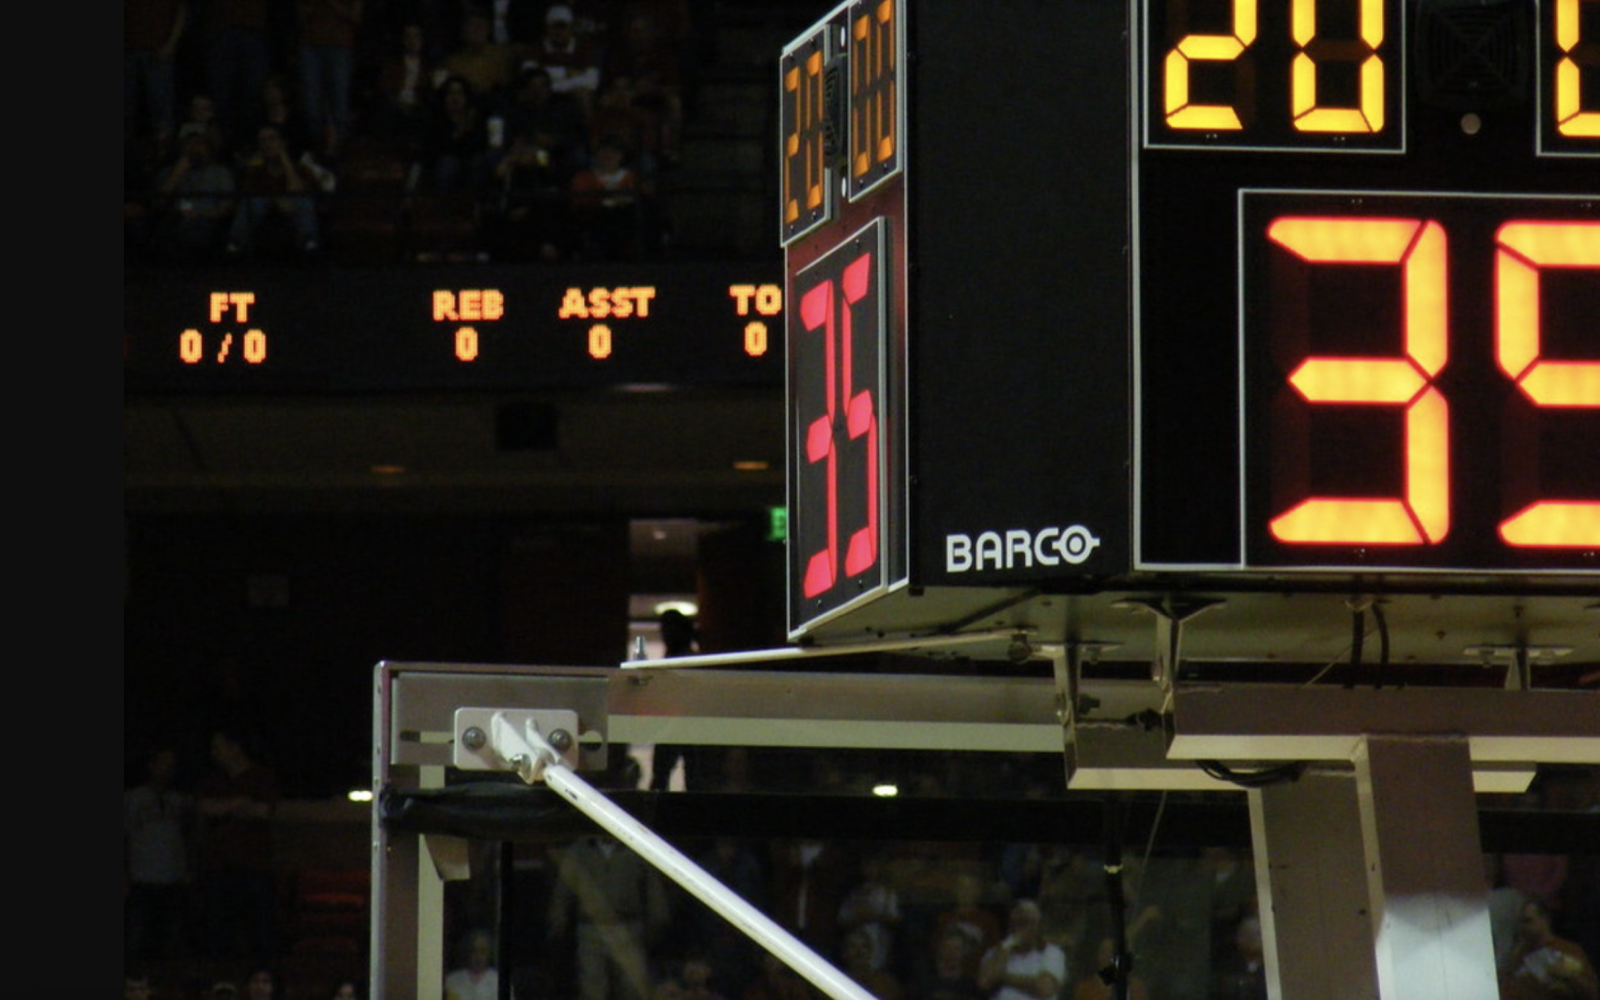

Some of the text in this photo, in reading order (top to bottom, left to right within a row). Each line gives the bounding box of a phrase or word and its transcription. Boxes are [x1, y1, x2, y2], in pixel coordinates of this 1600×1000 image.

[209, 284, 782, 323] FT REB ASST TO
[454, 326, 479, 362] 0
[588, 324, 612, 360] 0
[743, 321, 768, 357] 0
[946, 524, 1101, 574] BARCO
